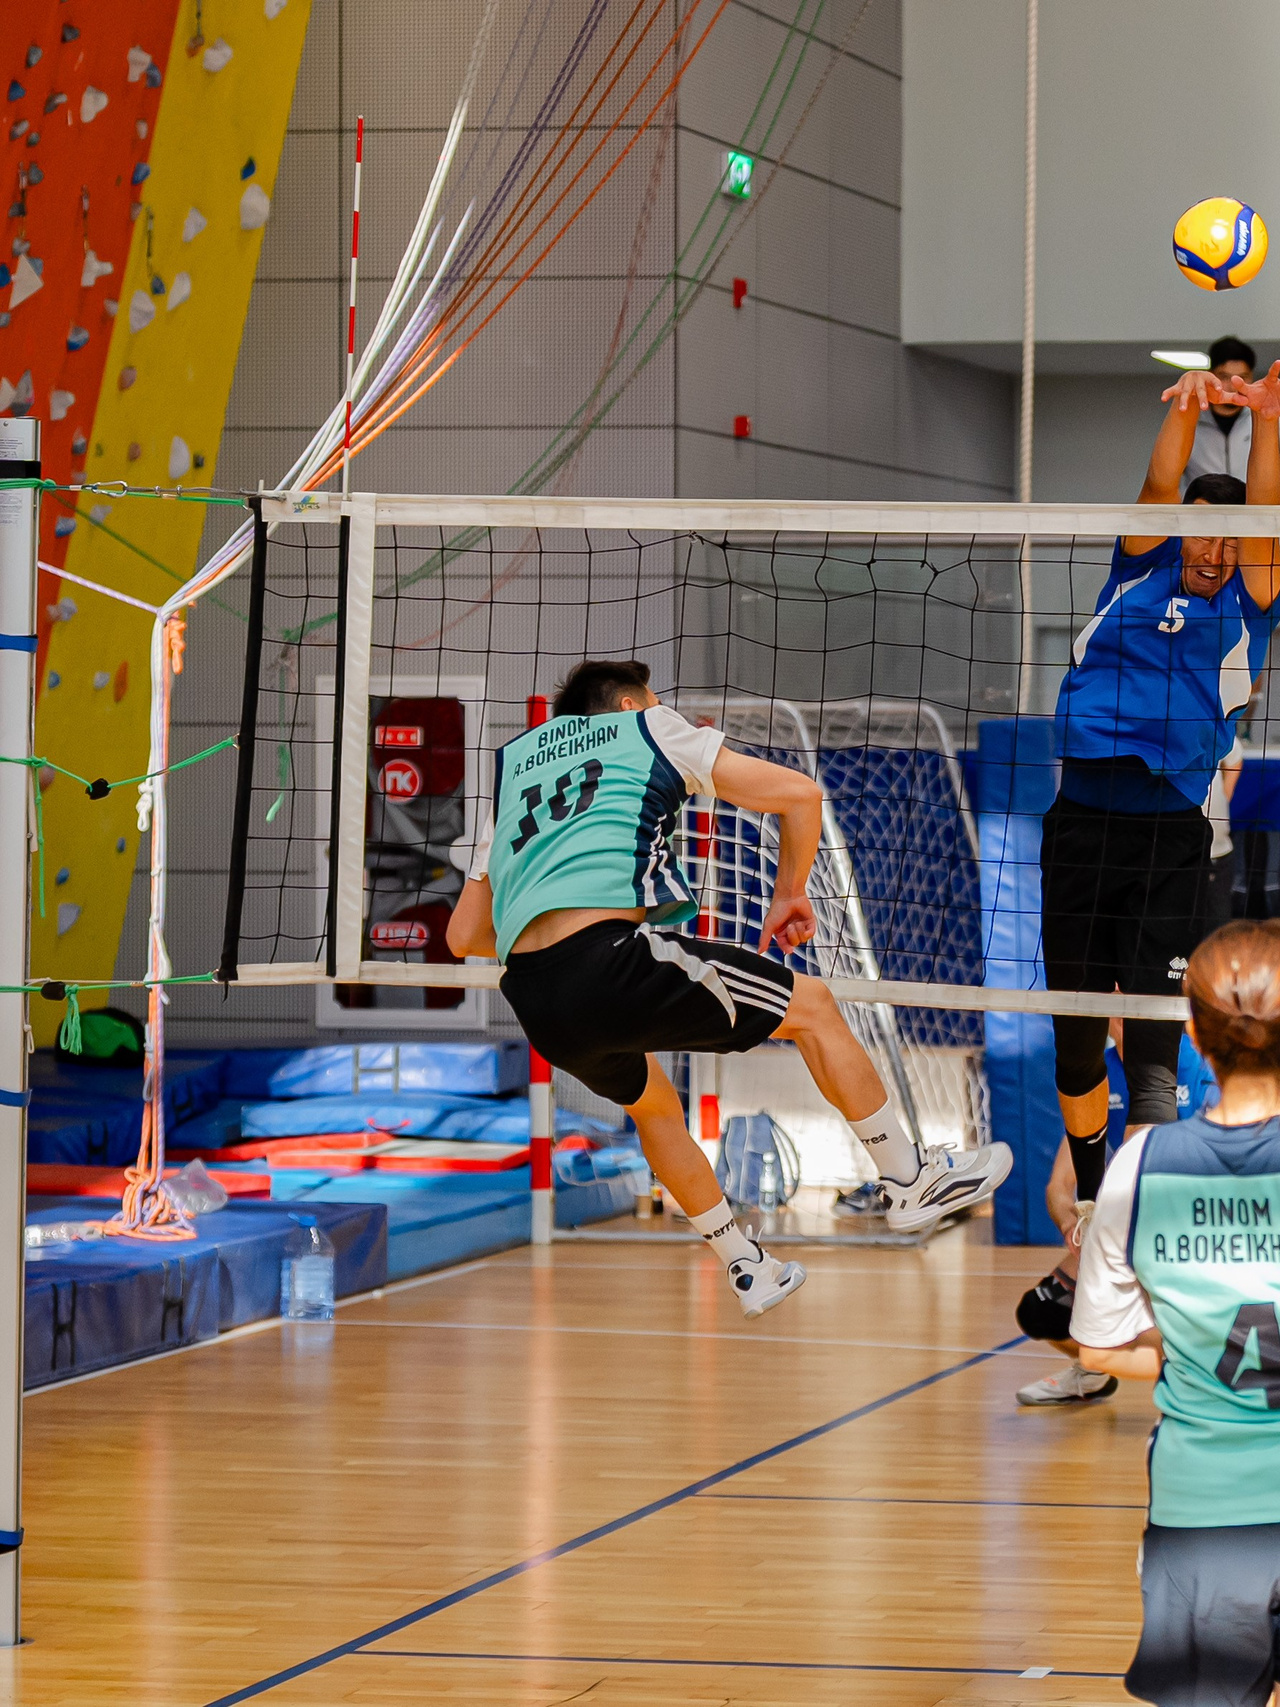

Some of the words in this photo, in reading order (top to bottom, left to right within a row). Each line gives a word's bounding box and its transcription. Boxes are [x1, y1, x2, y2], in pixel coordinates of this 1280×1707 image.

[1158, 597, 1189, 633] 5
[538, 717, 590, 749] BINOM
[513, 725, 619, 780] A.BOKEIKHAN
[510, 758, 604, 855] 10
[1192, 1198, 1272, 1226] BINOM
